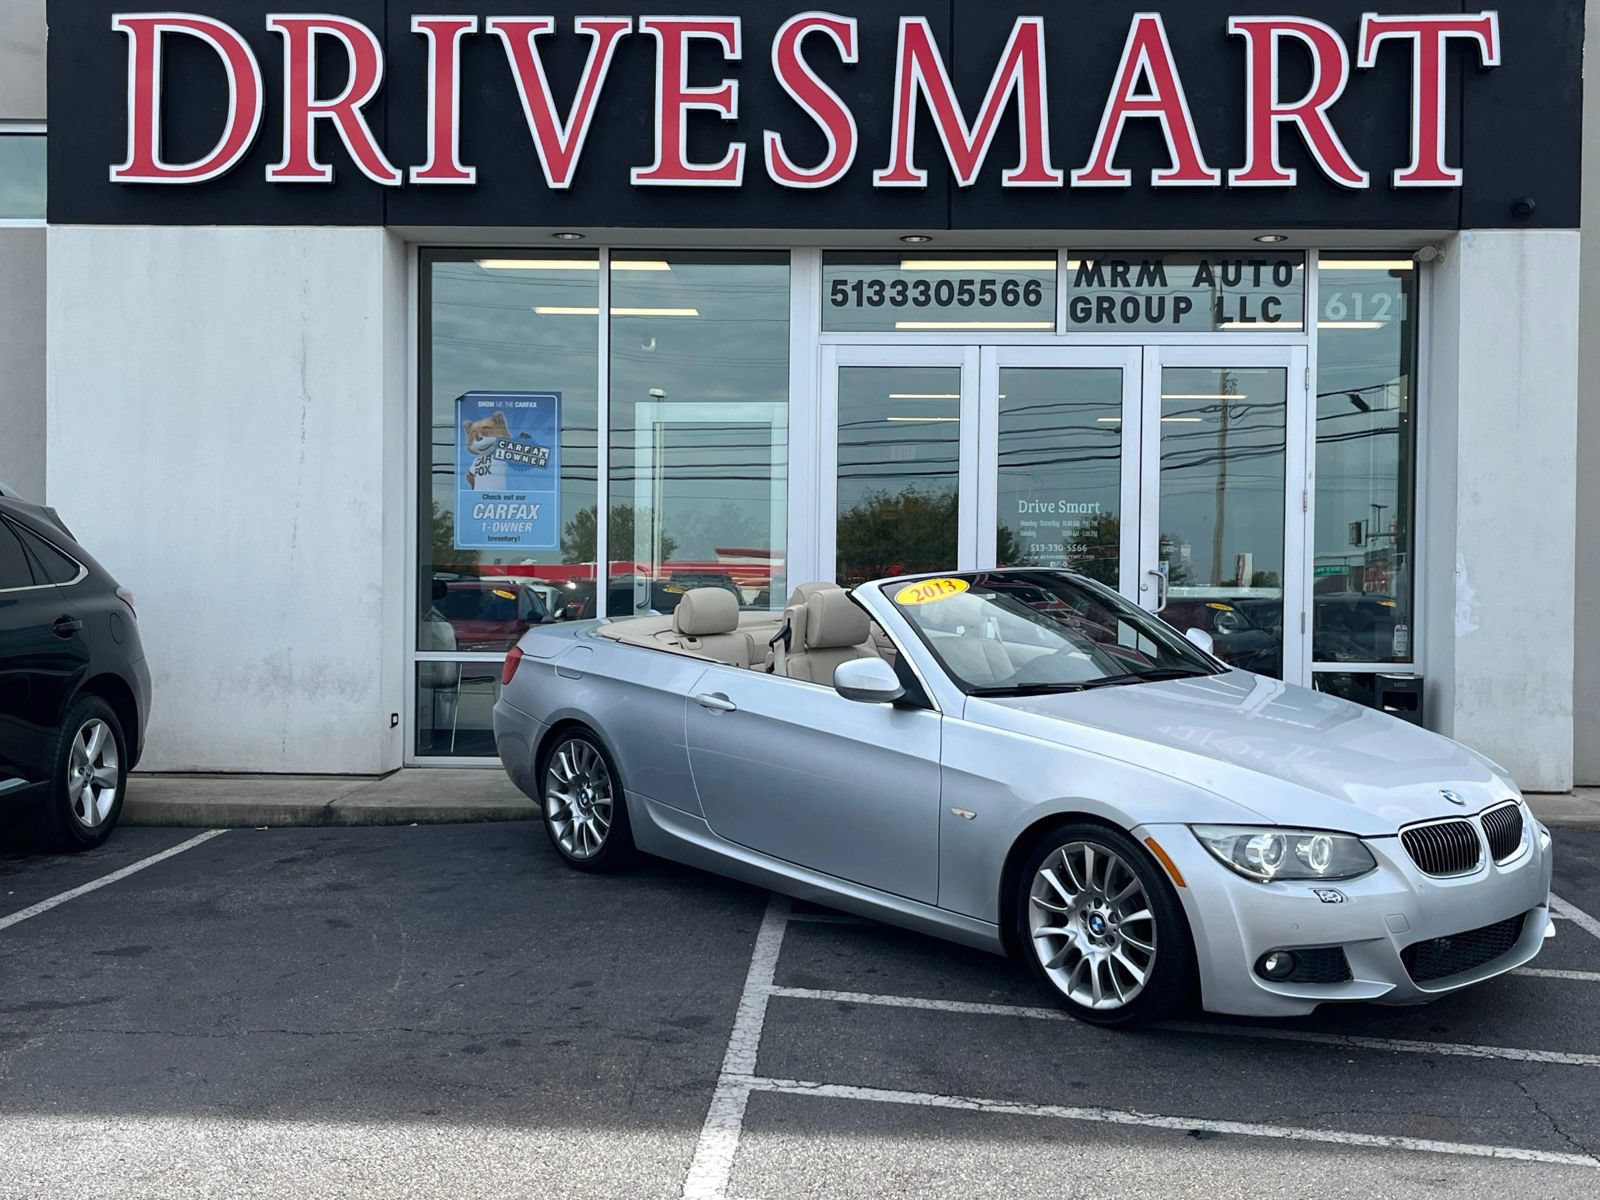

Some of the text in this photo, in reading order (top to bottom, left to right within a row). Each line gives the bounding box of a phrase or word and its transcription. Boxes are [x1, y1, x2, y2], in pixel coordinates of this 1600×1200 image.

[109, 10, 1501, 191] DRIVESMART
[1073, 260, 1293, 288] MRM AUTO
[830, 279, 1043, 307] 5133305566
[1069, 296, 1282, 324] GROUP LLC
[1325, 292, 1407, 321] 6121
[499, 440, 549, 459] CARFAX
[505, 452, 546, 467] OWNER
[474, 465, 492, 476] FOX
[472, 503, 541, 520] CARFAX
[1018, 500, 1101, 514] Drive Smart
[481, 521, 533, 533] 1-OWNER
[1030, 544, 1088, 552] 513-330-5566
[910, 580, 957, 602] 2013
